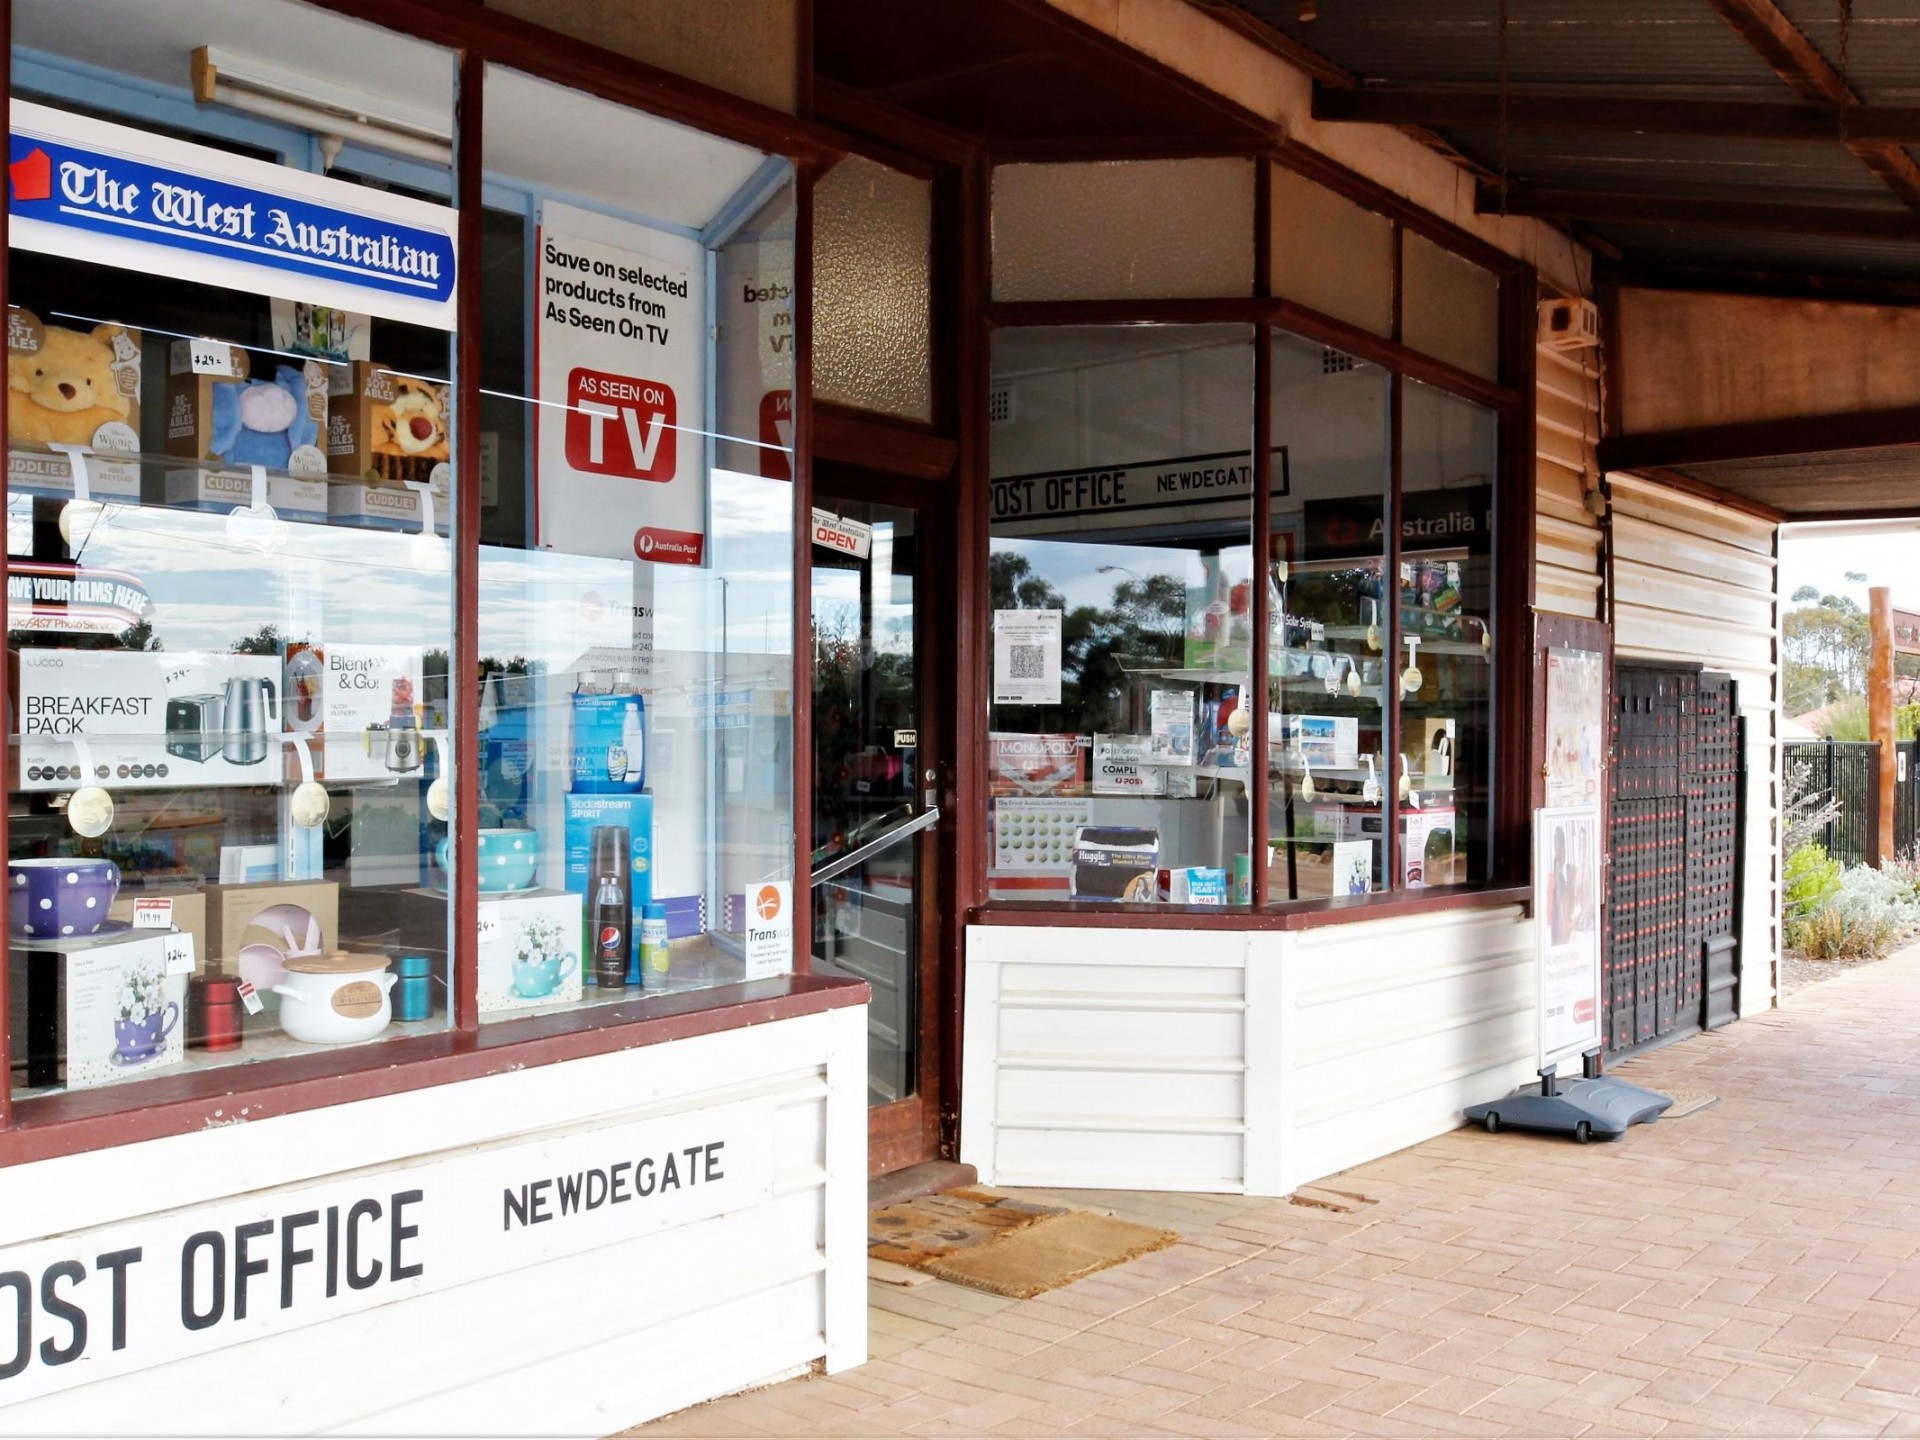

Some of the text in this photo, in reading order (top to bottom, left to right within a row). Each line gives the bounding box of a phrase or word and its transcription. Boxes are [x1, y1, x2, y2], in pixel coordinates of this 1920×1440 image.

[60, 162, 441, 280] The West Australian
[545, 244, 688, 299] Save on selected
[545, 276, 666, 319] products from
[8, 325, 33, 339] OFT
[545, 301, 669, 346] As Seen On TV
[367, 377, 392, 391] SOFT
[578, 375, 665, 407] AS SEEN ON
[364, 389, 395, 402] ABLES
[172, 403, 192, 417] SOFT
[169, 414, 194, 428] ABLES
[577, 398, 666, 472] TV
[8, 459, 69, 477] UDDLIES
[1045, 471, 1126, 511] OFFICE
[367, 493, 416, 511] CUDDLIES
[1369, 512, 1475, 539] Astralia
[655, 540, 698, 555] Australia Post
[816, 527, 857, 551] OPEN
[8, 576, 149, 615] AVE YOUR FILMS HERE
[25, 618, 53, 629] FAST
[1285, 614, 1300, 627] Solar
[639, 643, 653, 652] 240
[638, 655, 666, 665] regional
[339, 672, 380, 689] & Go!
[27, 696, 153, 716] BREAKFAST
[27, 717, 85, 735] PACK
[896, 734, 916, 744] PUSH
[1000, 742, 1076, 754] MONOPOLY
[571, 799, 631, 809] sodastream
[571, 809, 601, 818] SPIRIT
[1079, 850, 1105, 864] Huggle
[0, 1140, 726, 1380] OST OFFICE NEWDEGATE
